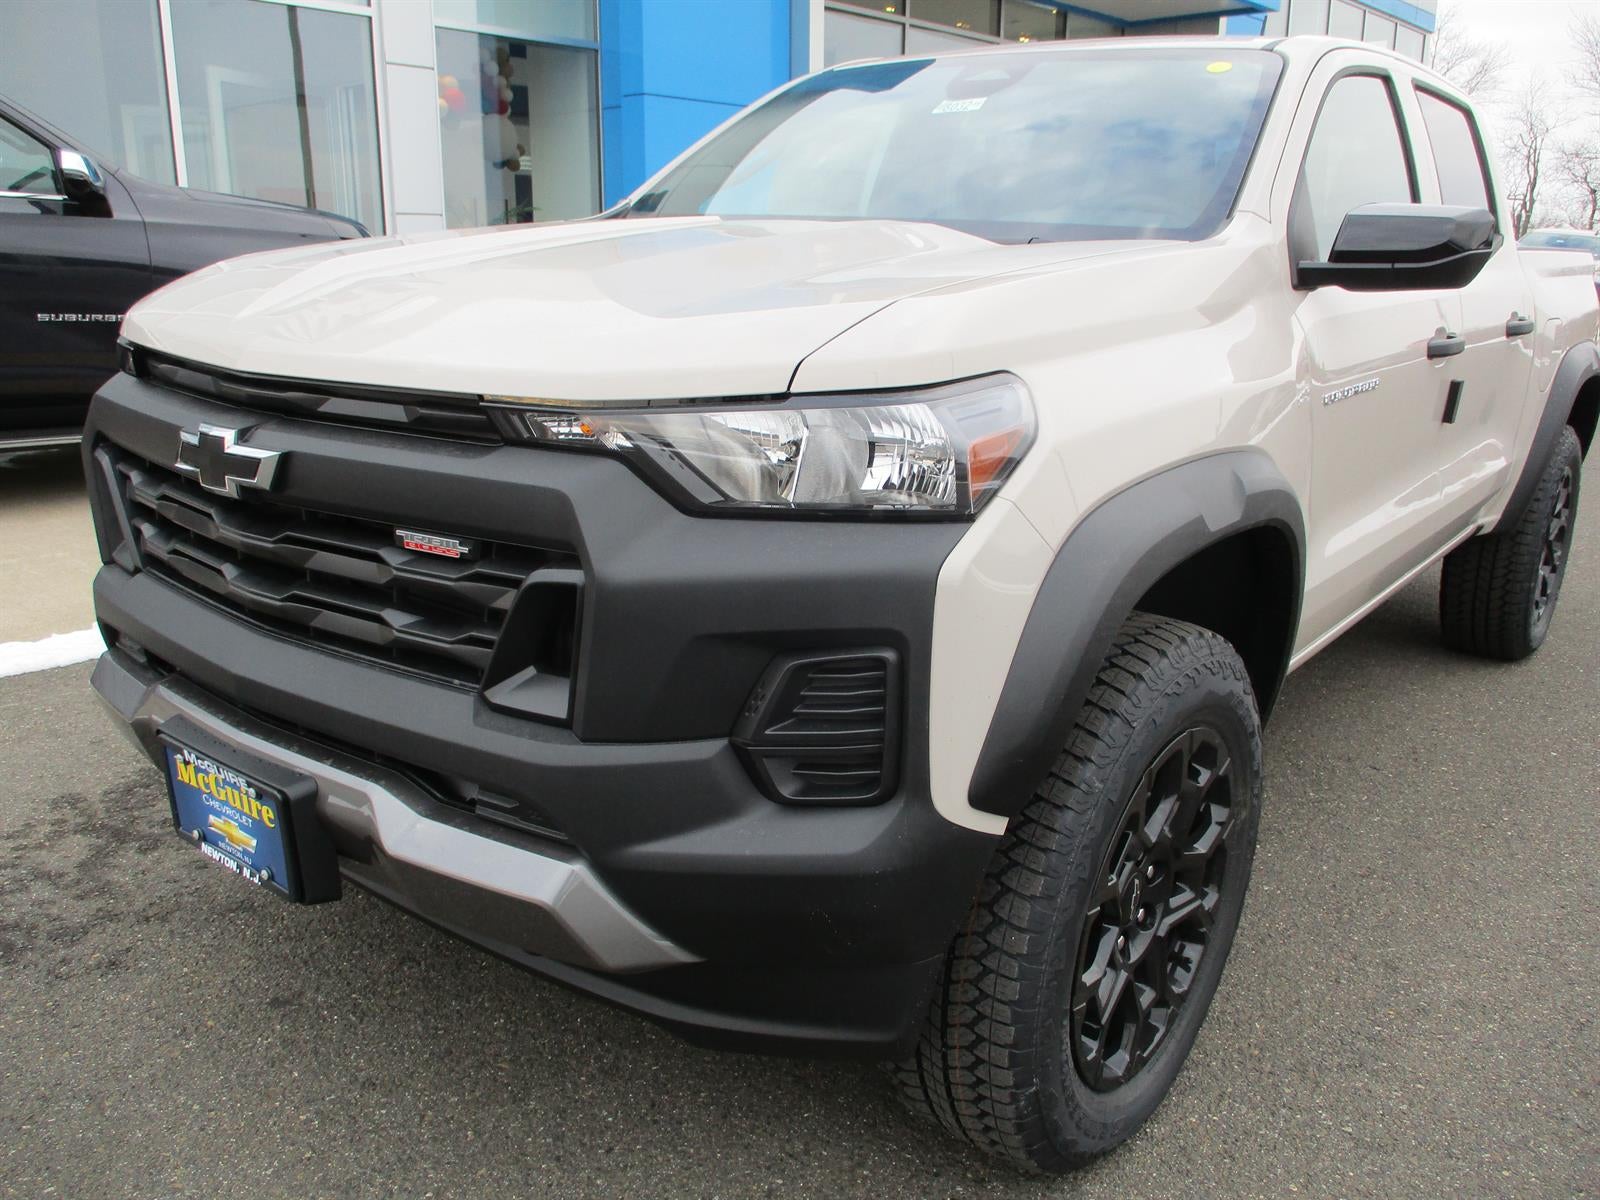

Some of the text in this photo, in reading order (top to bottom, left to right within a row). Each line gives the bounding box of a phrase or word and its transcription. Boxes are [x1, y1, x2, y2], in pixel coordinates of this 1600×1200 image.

[176, 758, 275, 828] McGuire
[202, 794, 253, 828] CHEVROLET
[201, 842, 262, 885] NEWTON, N.J.
